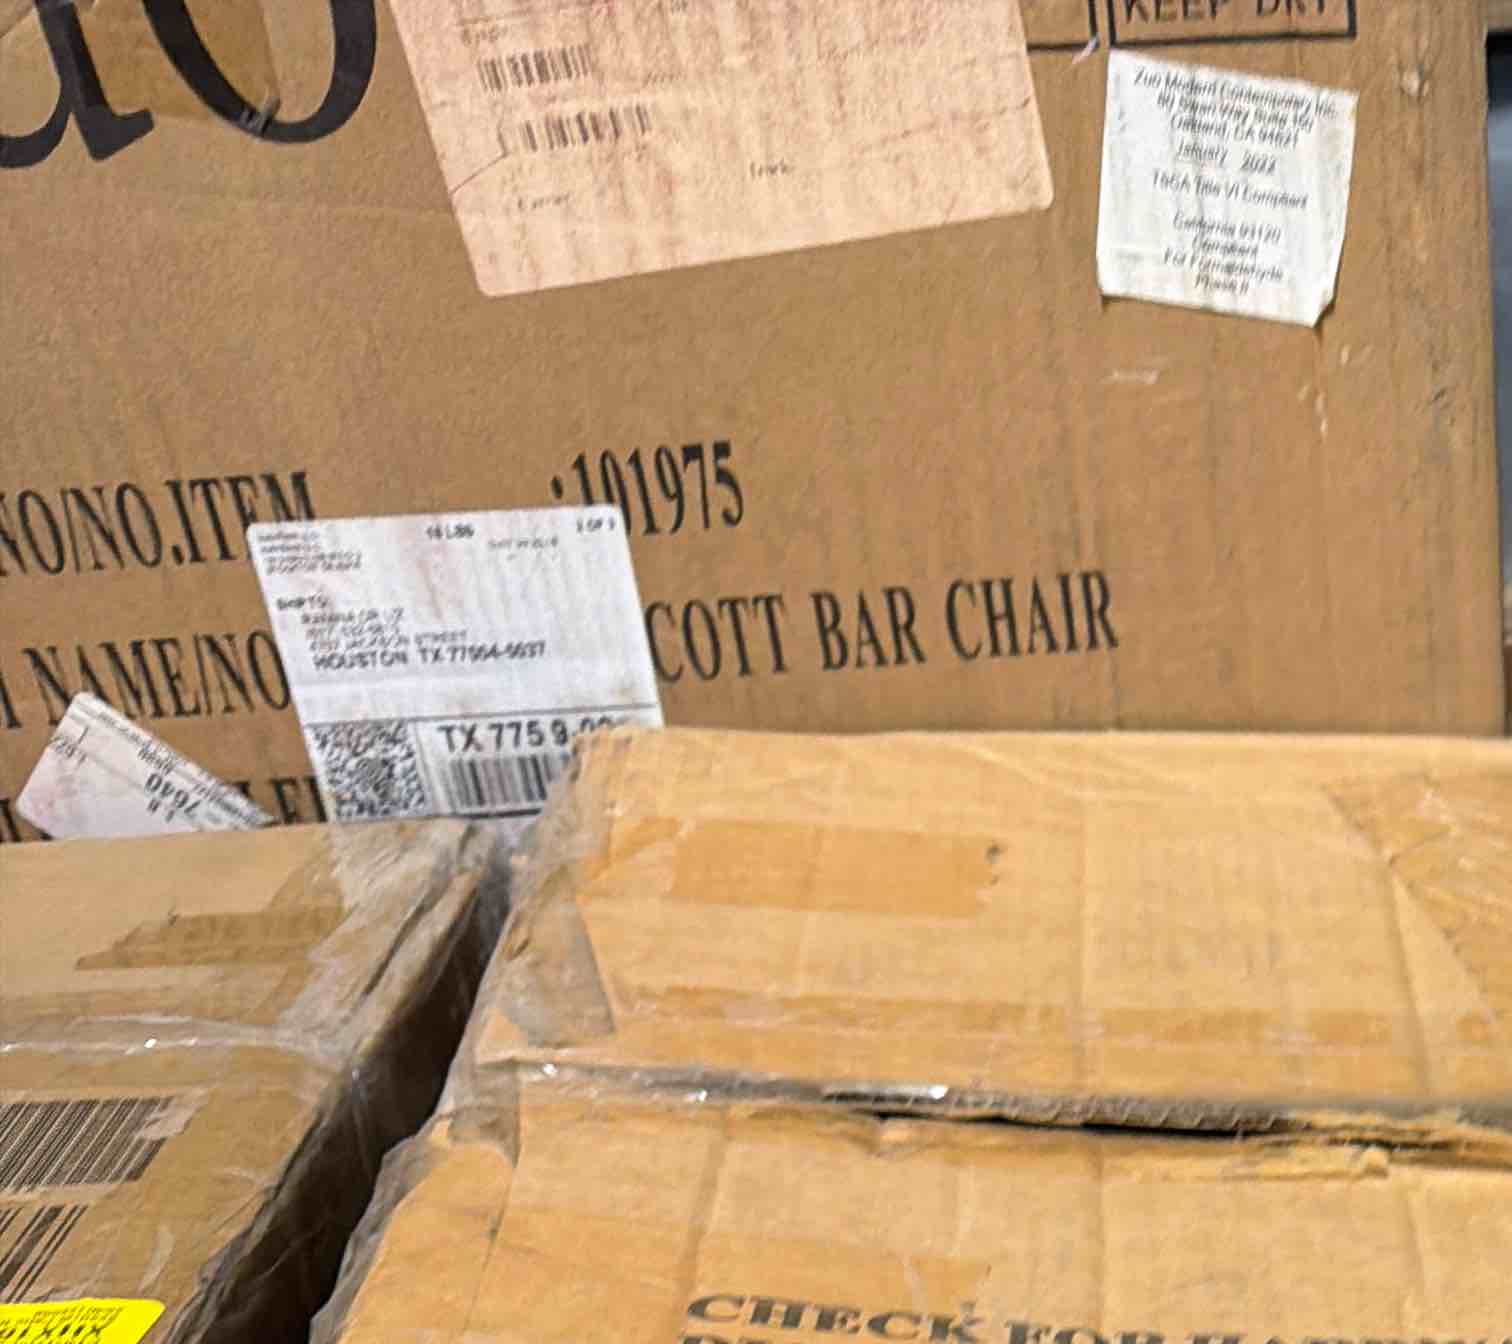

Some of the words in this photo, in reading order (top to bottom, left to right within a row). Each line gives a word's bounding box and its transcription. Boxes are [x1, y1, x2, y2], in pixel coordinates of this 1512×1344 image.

[809, 584, 927, 673] BAR
[943, 568, 1121, 664] CHAIR
[437, 725, 484, 752] TX
[488, 719, 546, 750] 775
[686, 1294, 987, 1344] CHECK
